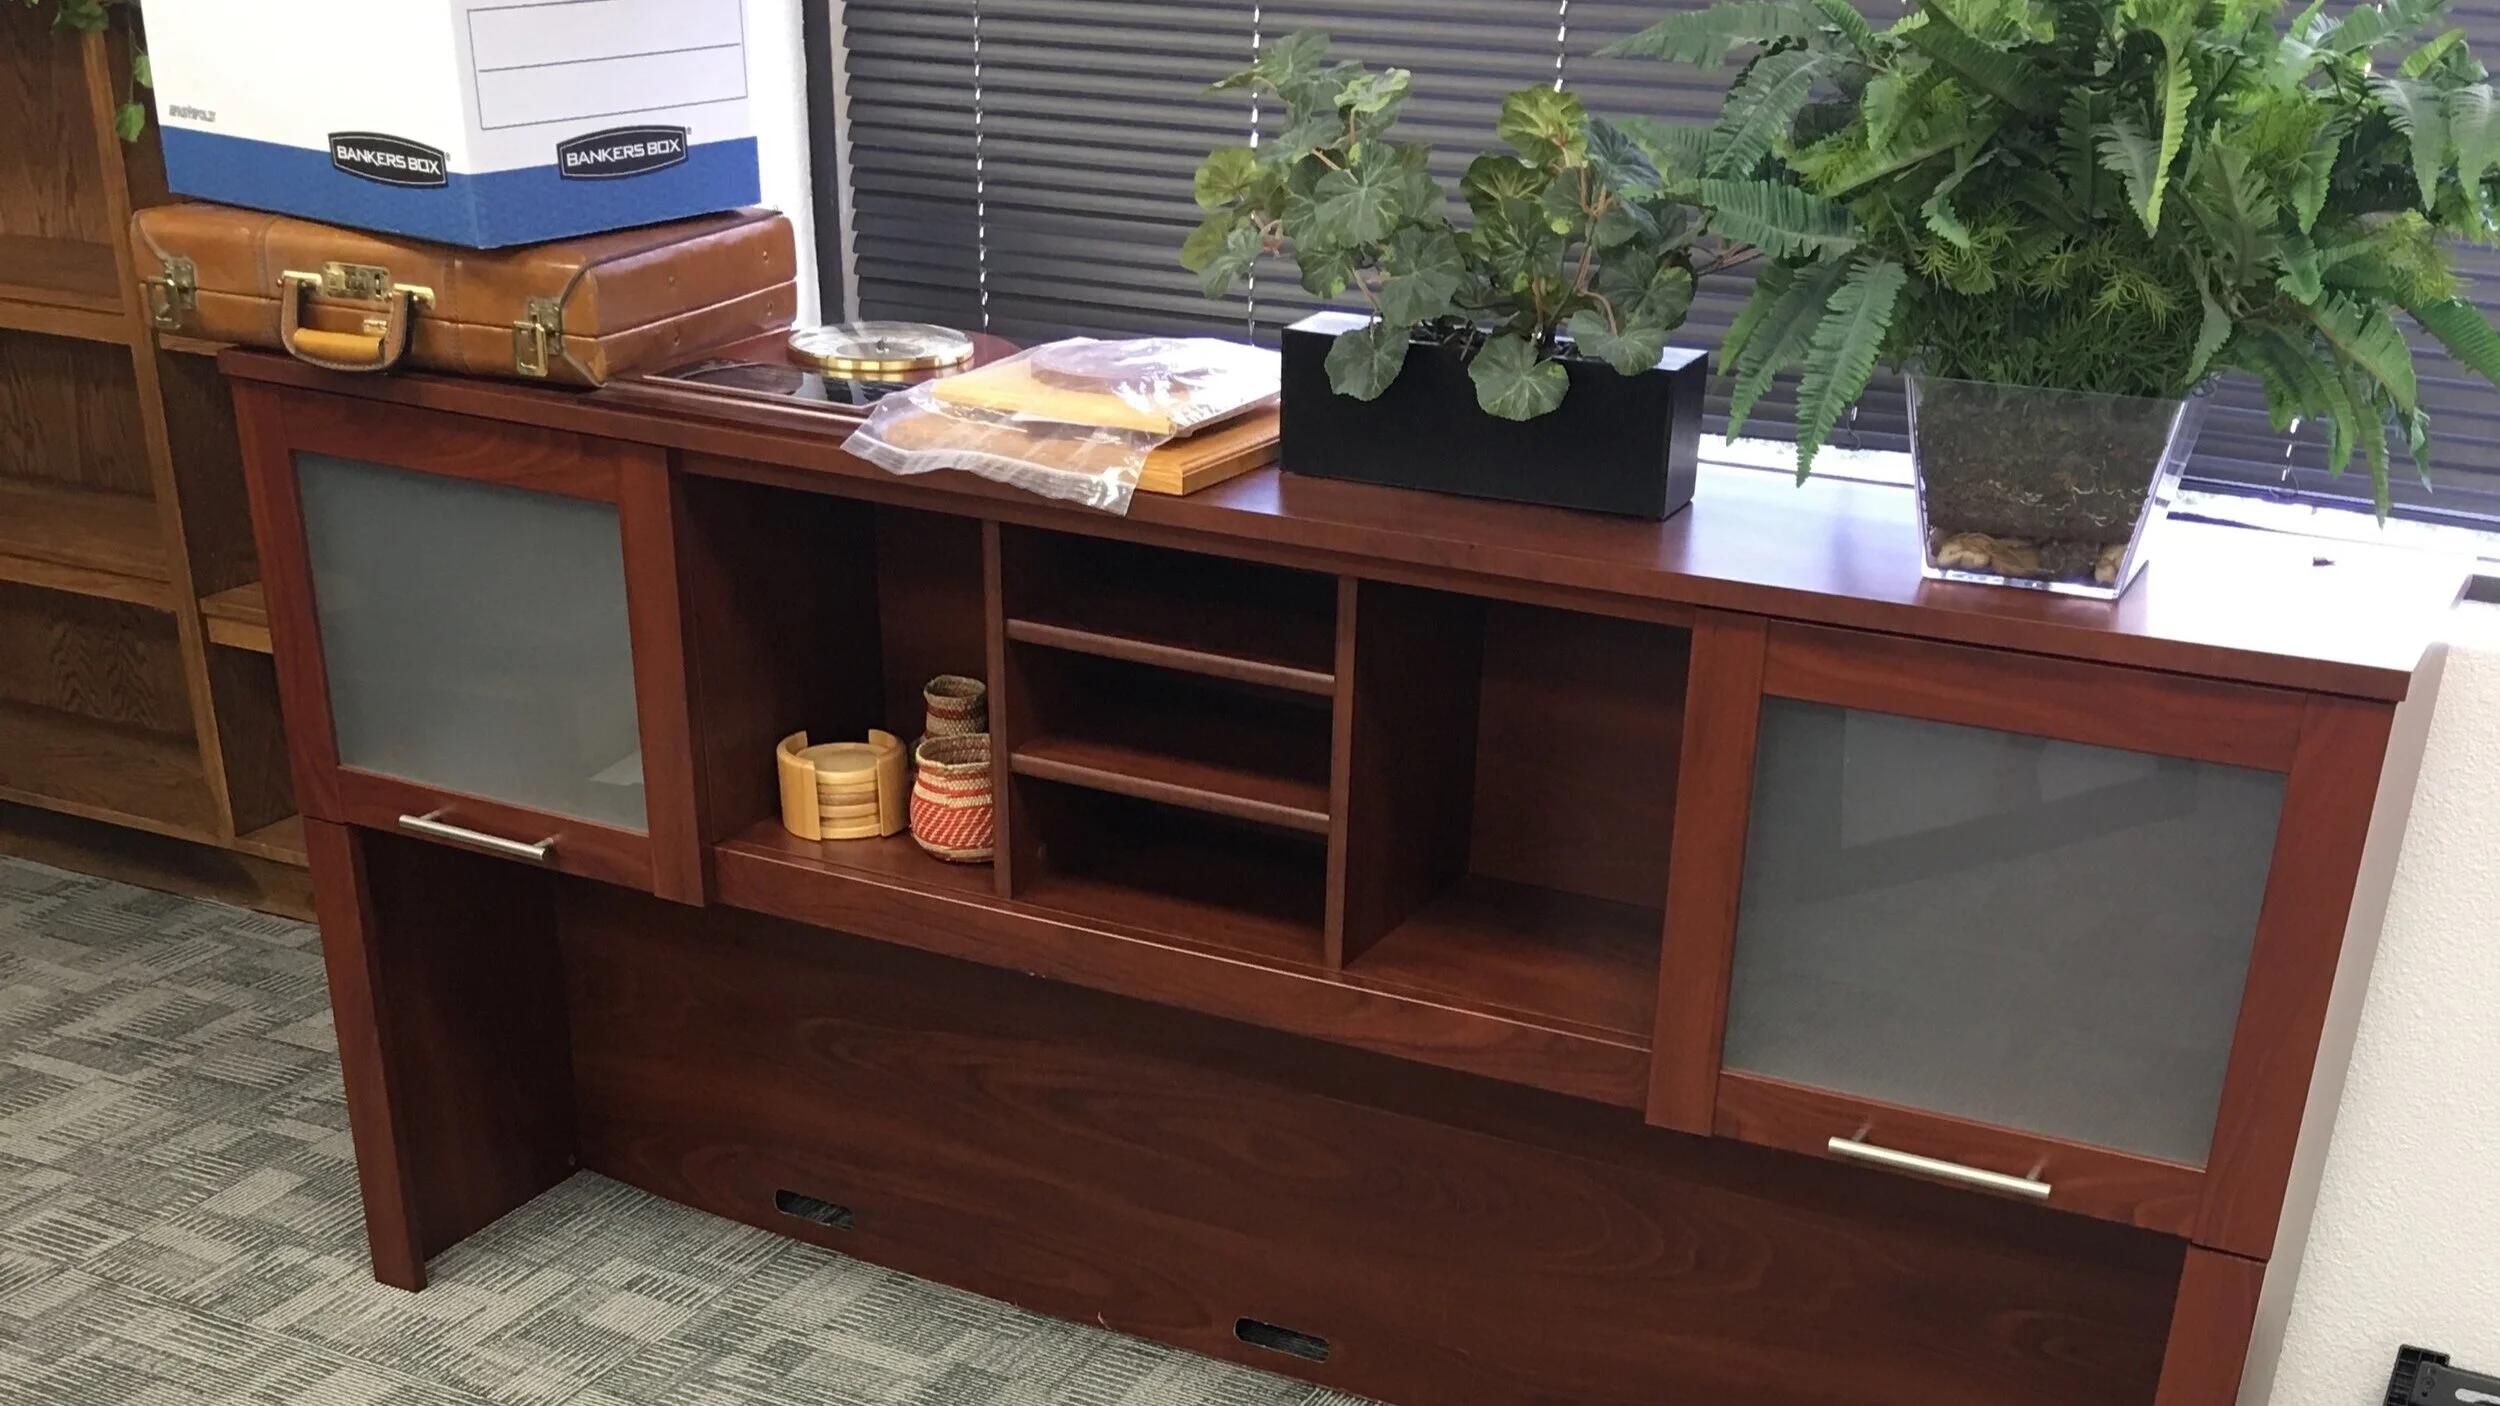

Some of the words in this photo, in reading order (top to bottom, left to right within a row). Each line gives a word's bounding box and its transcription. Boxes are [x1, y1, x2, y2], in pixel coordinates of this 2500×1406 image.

[337, 145, 406, 170] BANKERS
[407, 156, 442, 176] BOX
[566, 143, 645, 167] BANKERS
[646, 138, 682, 156] BOX
